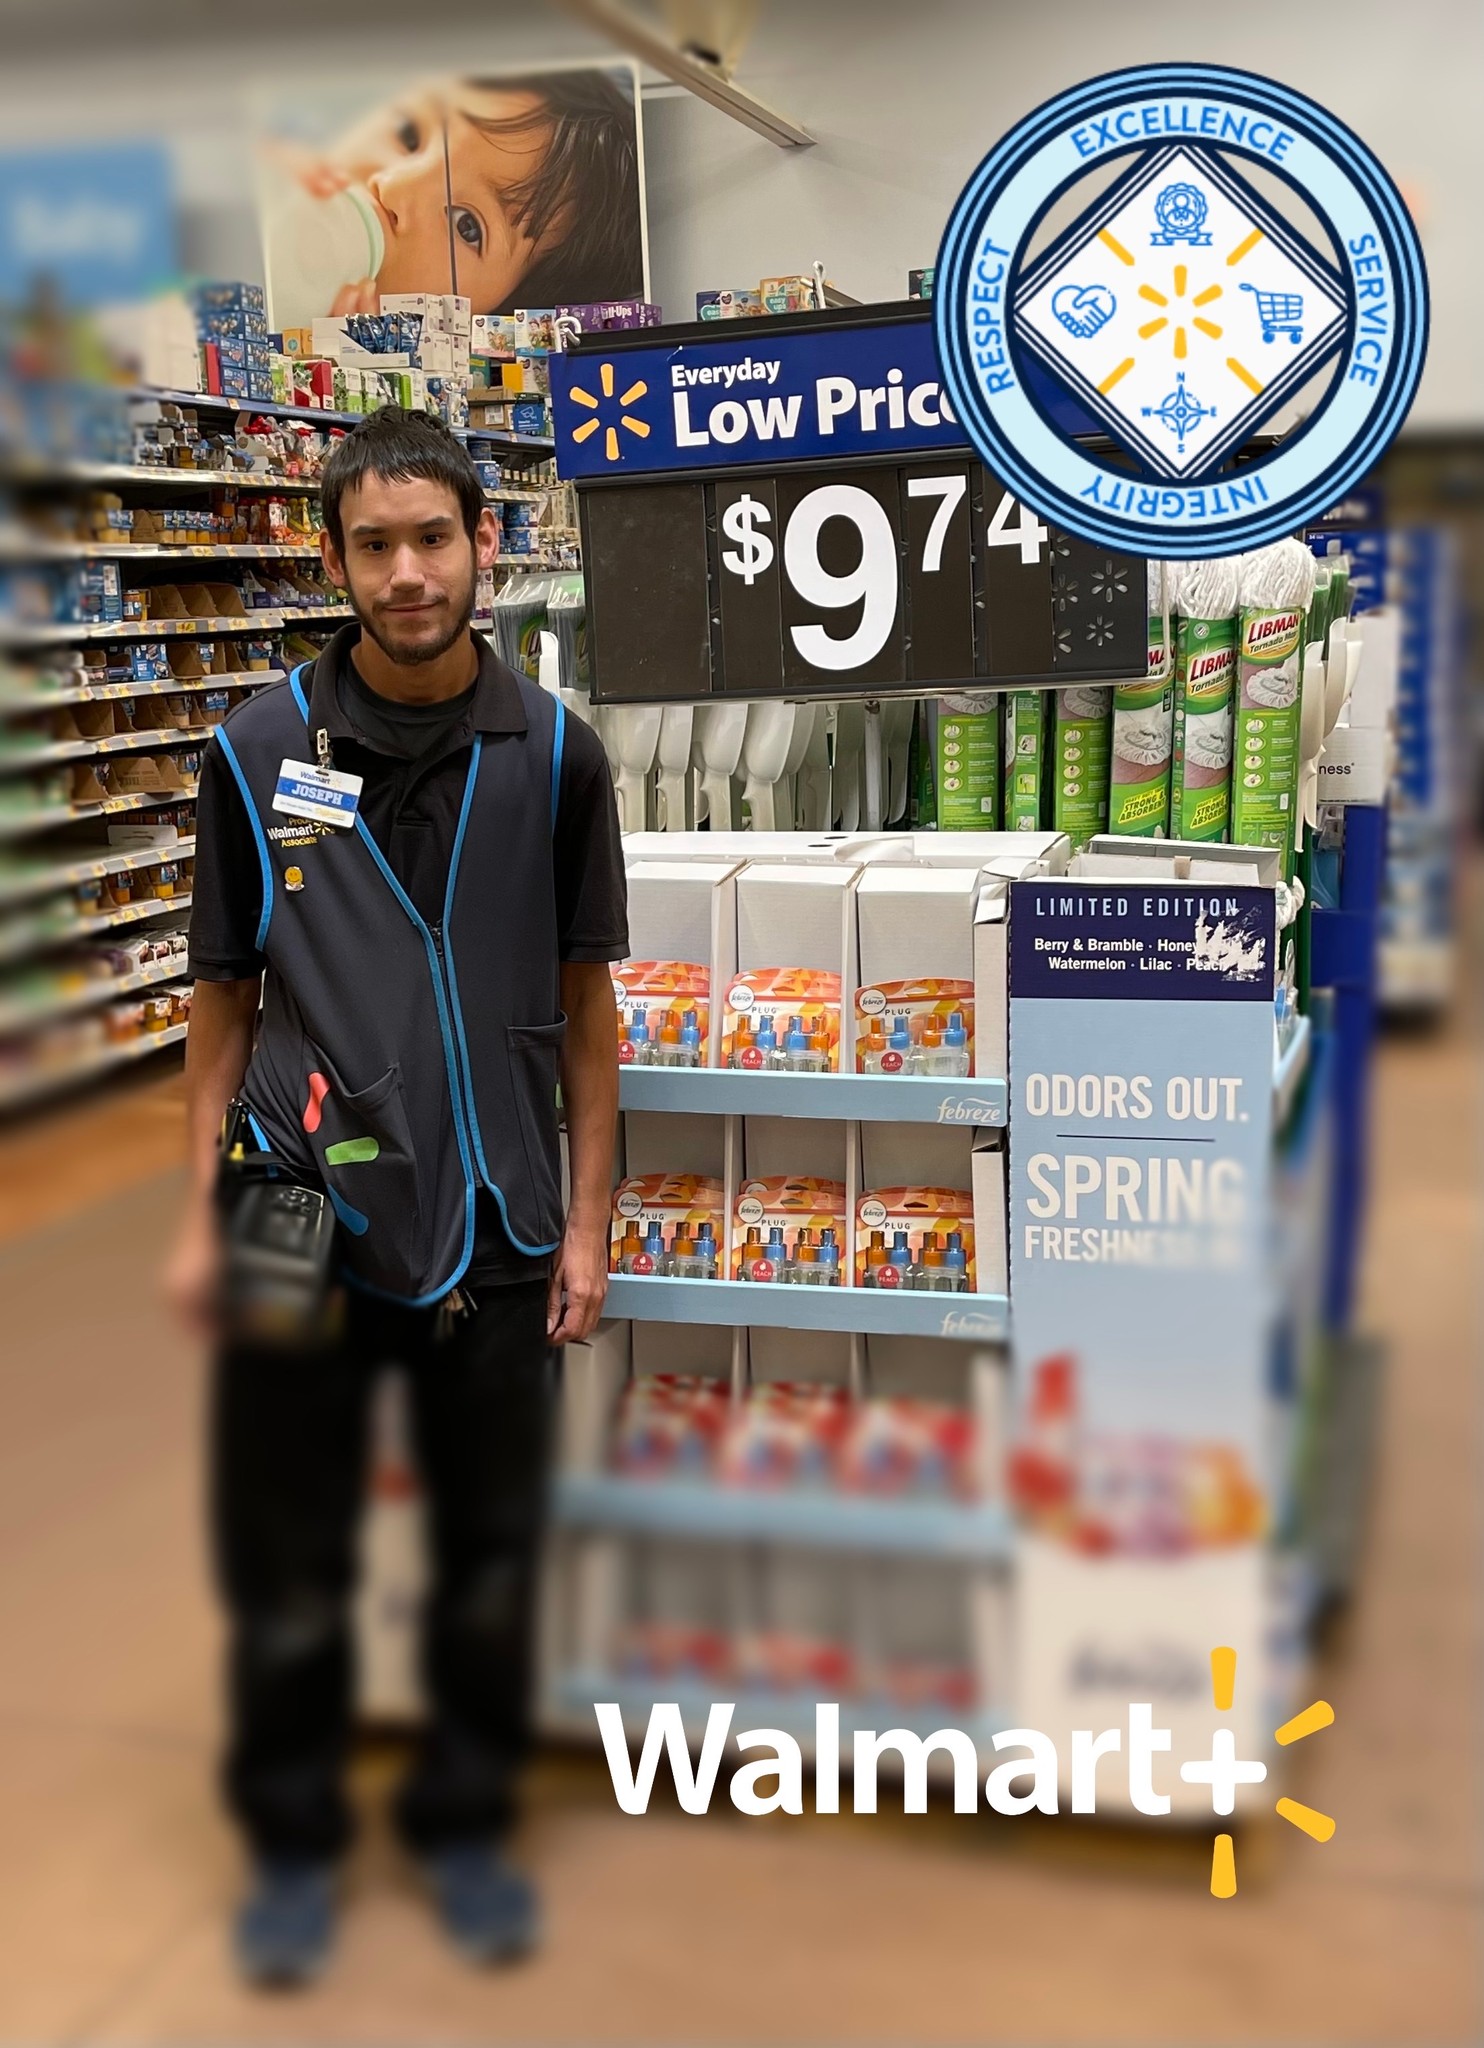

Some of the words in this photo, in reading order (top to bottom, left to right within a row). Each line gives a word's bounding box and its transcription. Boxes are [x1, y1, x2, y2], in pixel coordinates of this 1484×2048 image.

[671, 358, 781, 389] Everyday
[672, 392, 803, 448] Low
[1248, 613, 1299, 644] LIBMAN
[1249, 635, 1284, 655] Tornado
[300, 771, 331, 785] Walmart
[291, 783, 344, 806] JOSEPH
[1124, 795, 1157, 812] STRONG
[267, 825, 315, 840] Walmart
[281, 836, 318, 848] Associate
[1035, 897, 1128, 917] LIMITED
[1143, 897, 1238, 918] EDITION
[1034, 938, 1069, 954] Berry
[1073, 938, 1084, 951] &
[1088, 938, 1144, 951] Bramble
[1048, 956, 1126, 971] Watermelon
[1139, 956, 1173, 971] Lilac
[624, 1001, 649, 1009] PLUG
[752, 1006, 777, 1014] PLUG
[884, 1008, 912, 1016] PLUG
[1026, 1073, 1153, 1119] ODORS
[1166, 1076, 1250, 1123] OUT.
[937, 1096, 1000, 1123] febreze
[1026, 1152, 1245, 1224] SPRING
[639, 1212, 665, 1221] PLUG
[761, 1219, 787, 1227] PLUG
[884, 1222, 911, 1230] PLUG
[1024, 1225, 1197, 1264] FRESHNE
